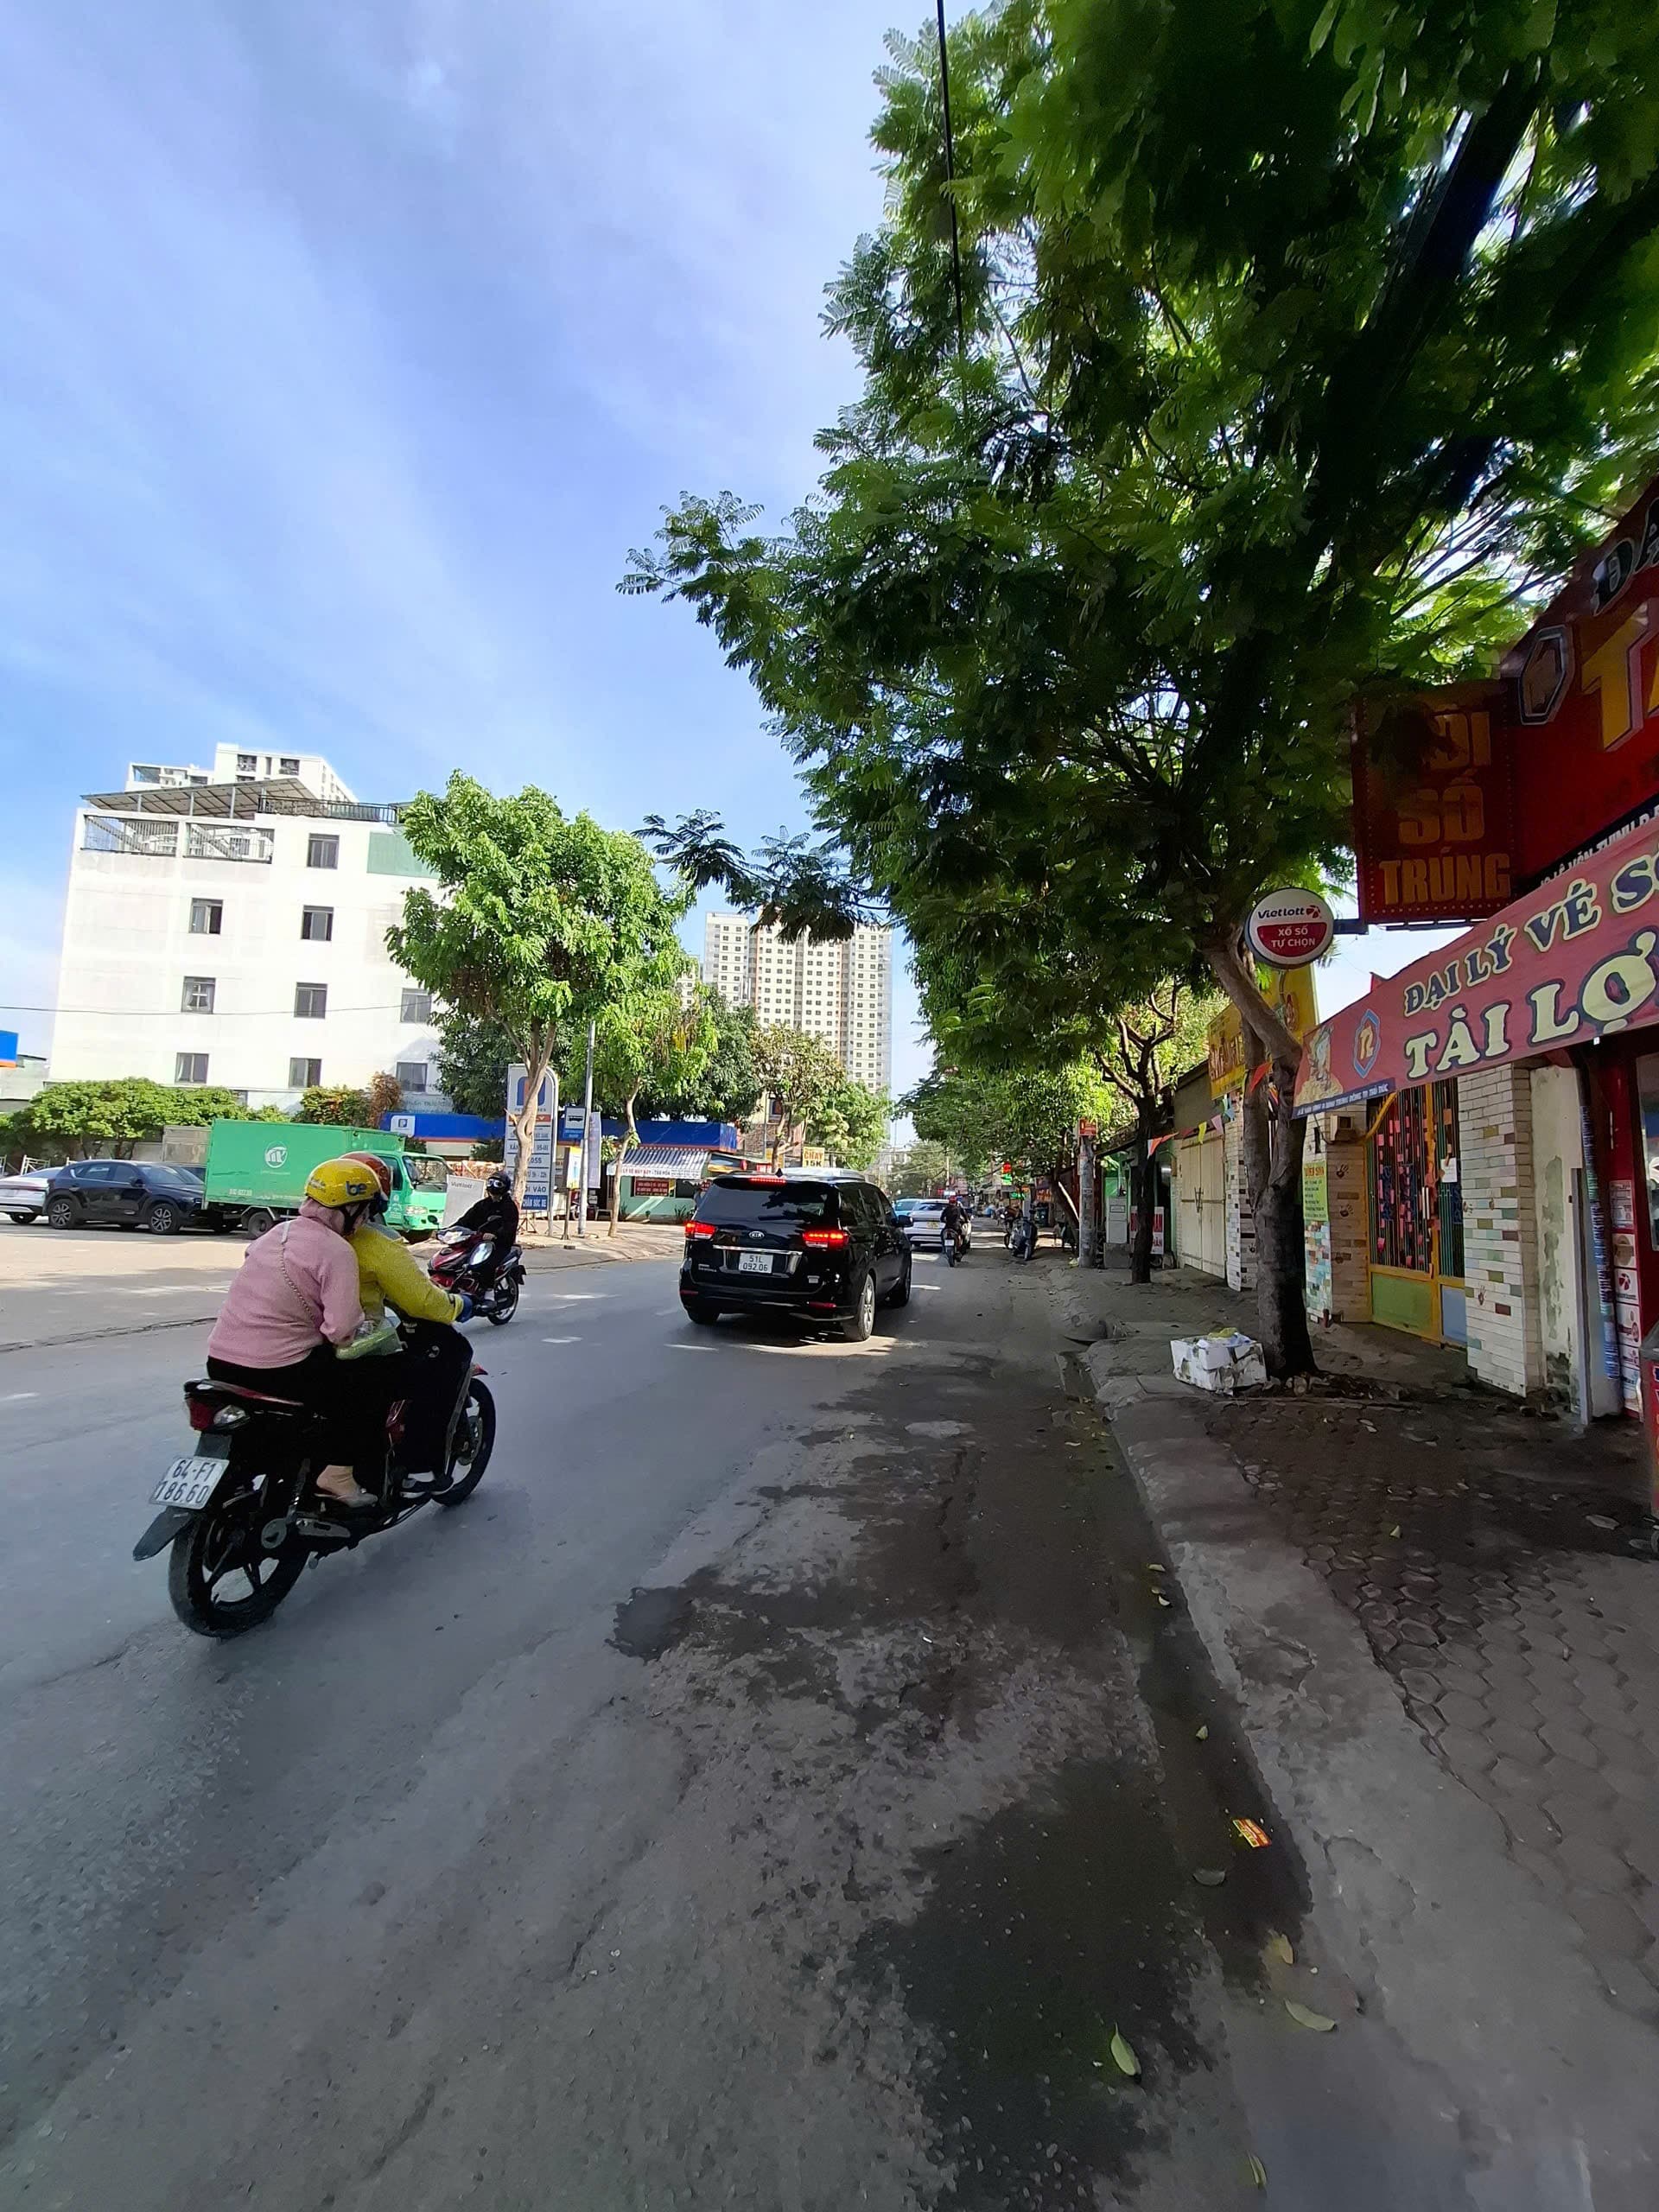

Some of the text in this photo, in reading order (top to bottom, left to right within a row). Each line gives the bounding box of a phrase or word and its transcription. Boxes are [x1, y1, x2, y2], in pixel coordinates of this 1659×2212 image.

[1379, 846, 1512, 906] TRÚNG
[1258, 907, 1305, 919] Vietlott
[1404, 843, 1659, 1017] ĐẠI LÝ VÉ S
[1287, 938, 1316, 948] CHỌN
[1527, 928, 1659, 1044] LỢ
[346, 1180, 367, 1196] be
[743, 1262, 768, 1272] 092.06
[173, 1459, 216, 1482] 64-F1
